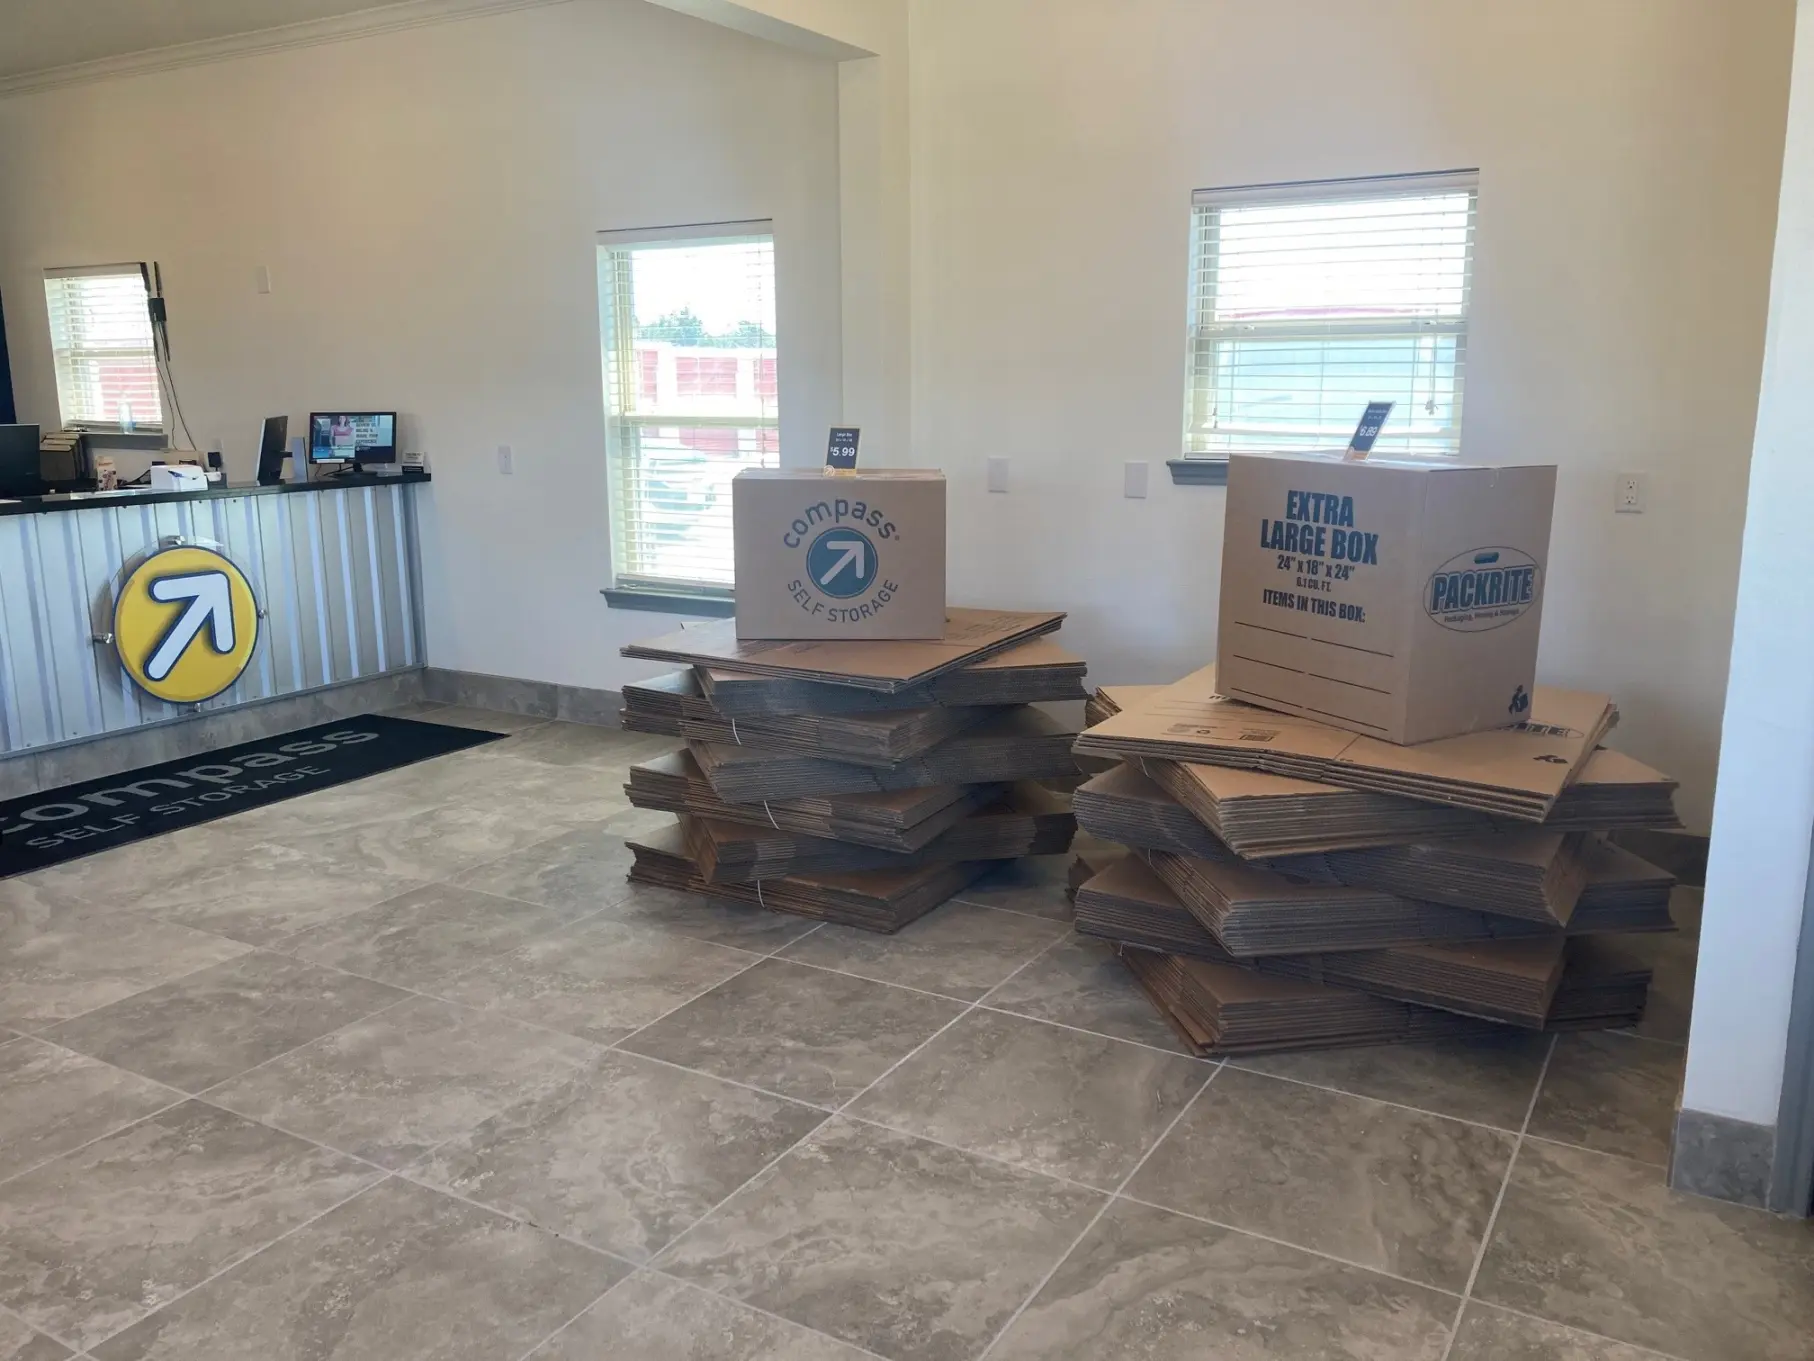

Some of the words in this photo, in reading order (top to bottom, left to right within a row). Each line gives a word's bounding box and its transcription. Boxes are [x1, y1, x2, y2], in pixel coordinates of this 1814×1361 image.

[830, 447, 855, 456] $5.99
[784, 499, 896, 548] compass
[1286, 490, 1354, 528] EXTRA
[1261, 519, 1326, 556] LARGE
[1331, 528, 1378, 565] BOX
[788, 580, 825, 615] SELF
[828, 580, 898, 623] STORAGE
[1263, 589, 1295, 609] ITEMS
[1297, 595, 1309, 612] IN
[1311, 598, 1337, 617] THIS
[1431, 564, 1534, 615] PACKRITE
[25, 813, 141, 849] SELF
[150, 766, 331, 816] STORAGE
